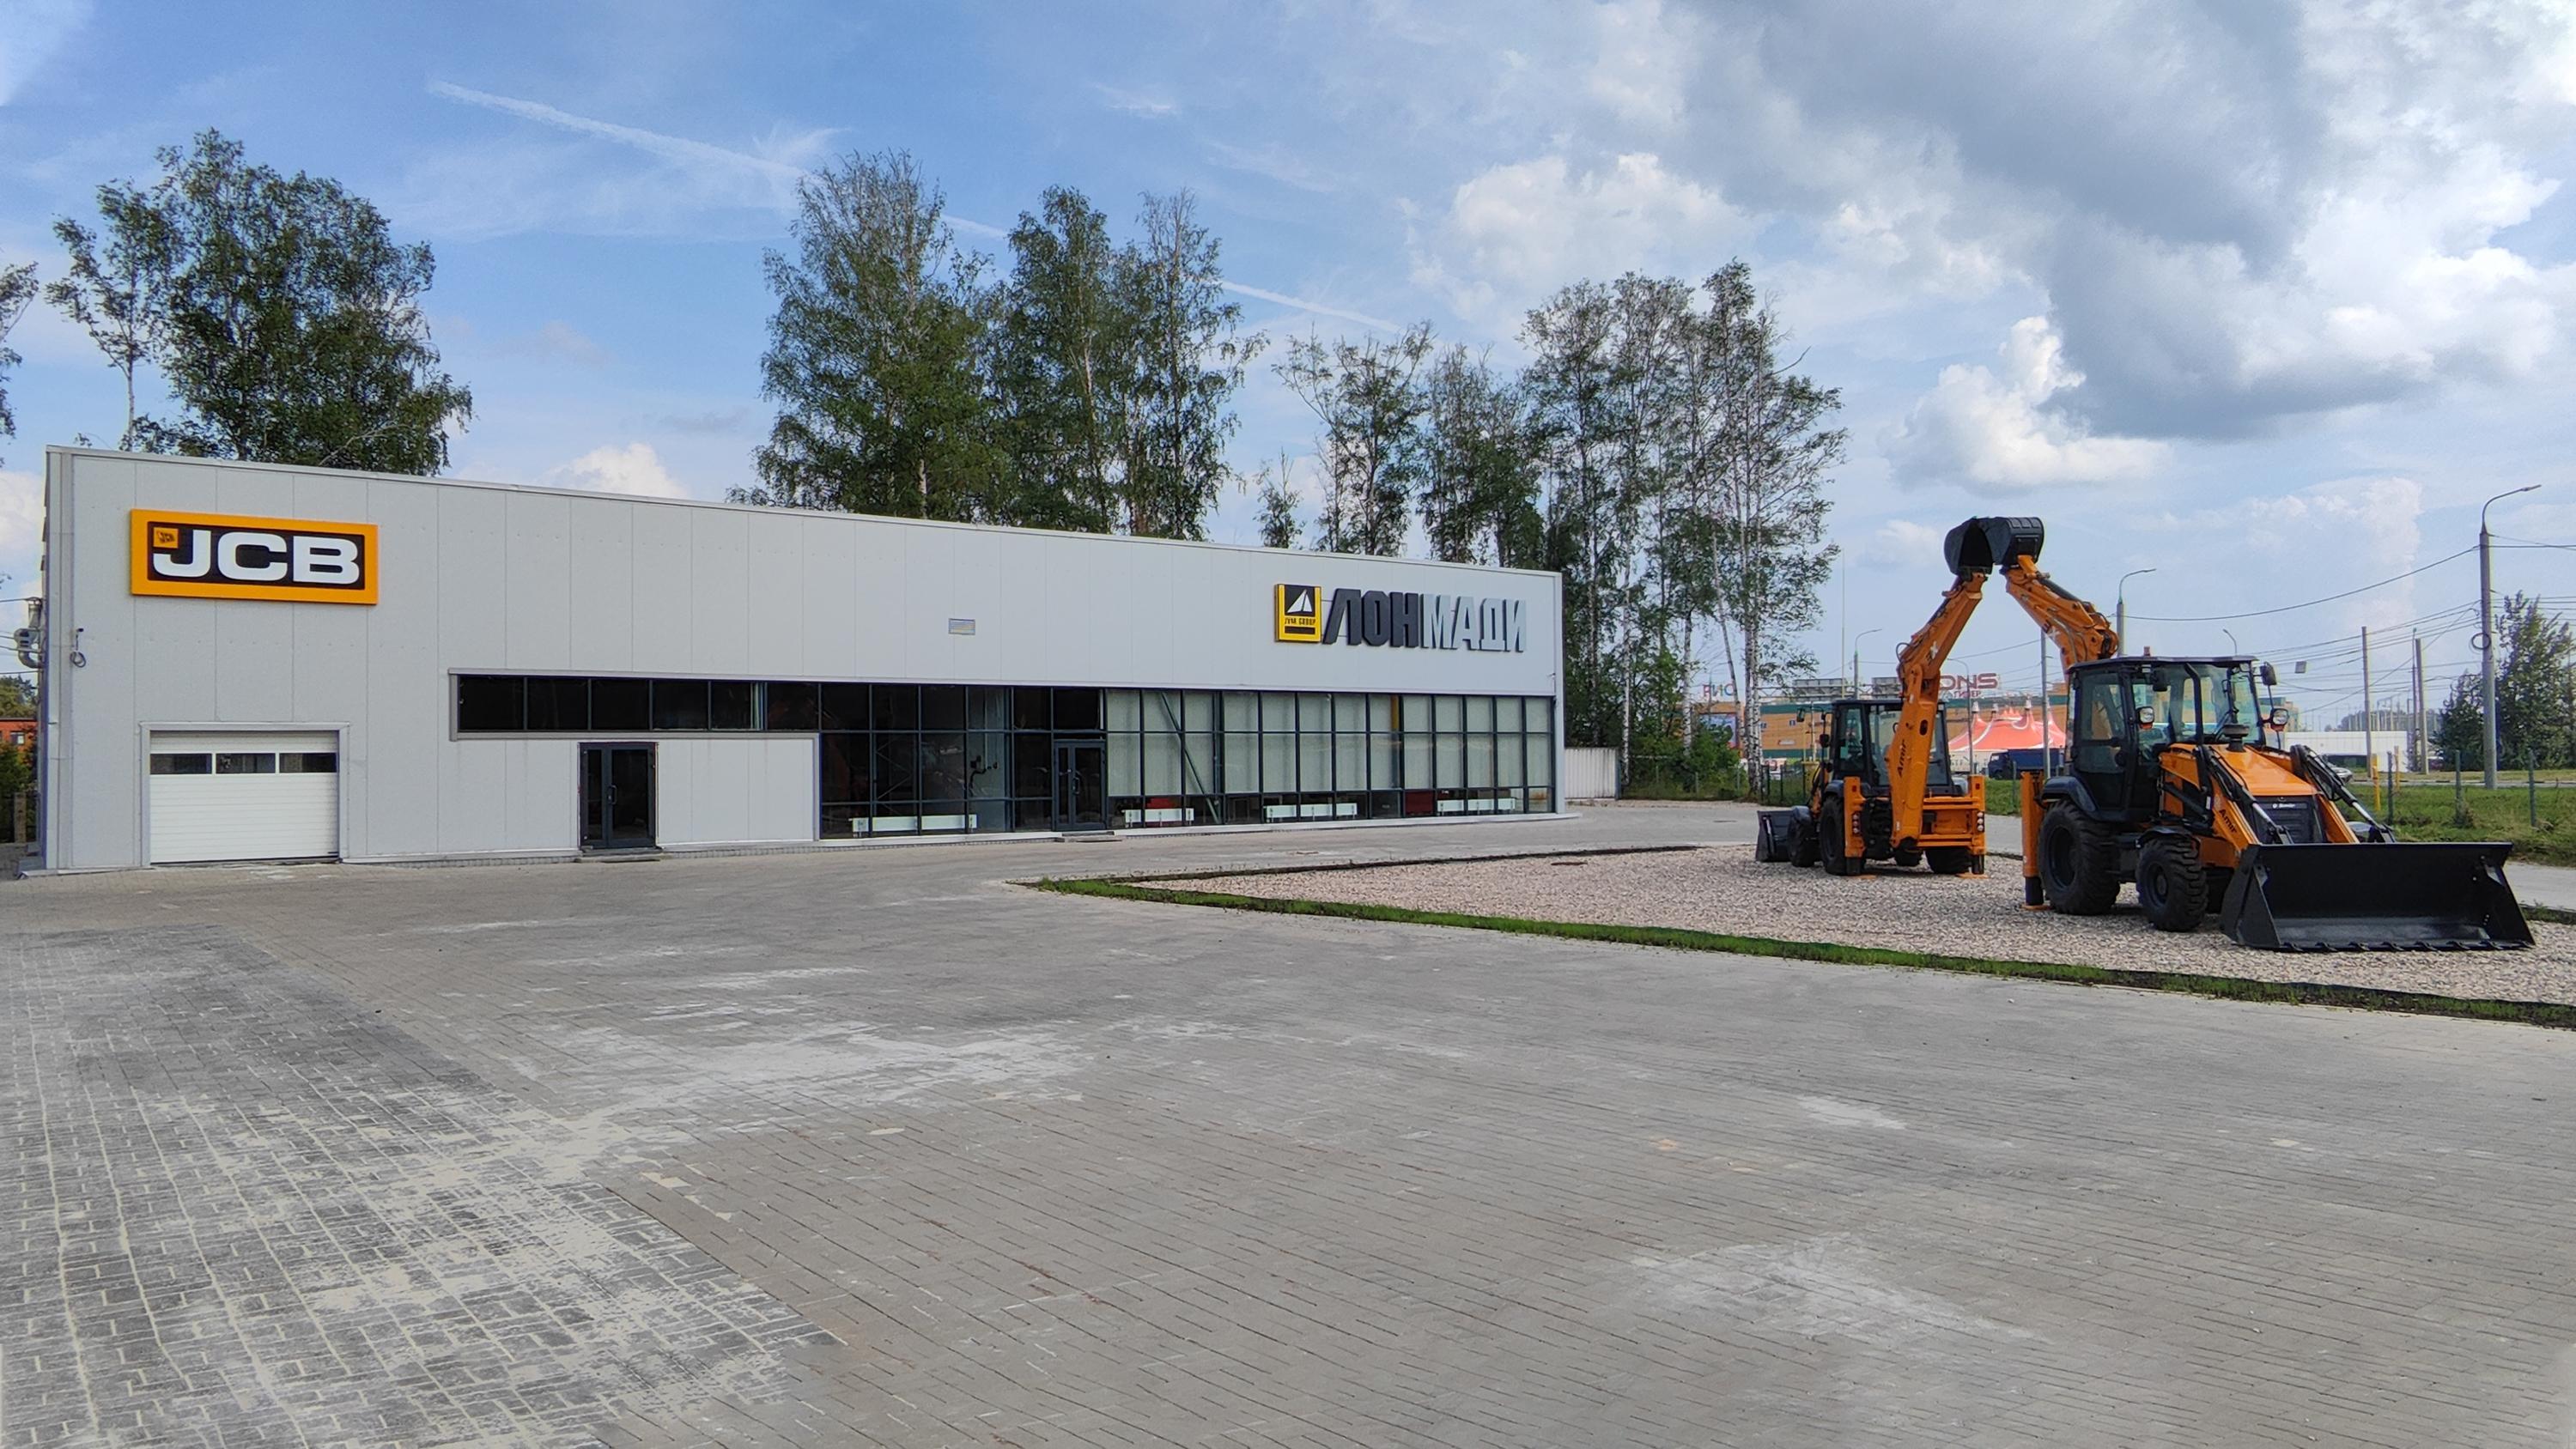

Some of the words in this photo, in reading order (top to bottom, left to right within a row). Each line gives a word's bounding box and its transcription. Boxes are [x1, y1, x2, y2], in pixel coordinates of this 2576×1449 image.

[153, 529, 361, 585] JCB
[1322, 588, 1527, 652] ЛОНМАДИ
[1939, 673, 1998, 690] DNS
